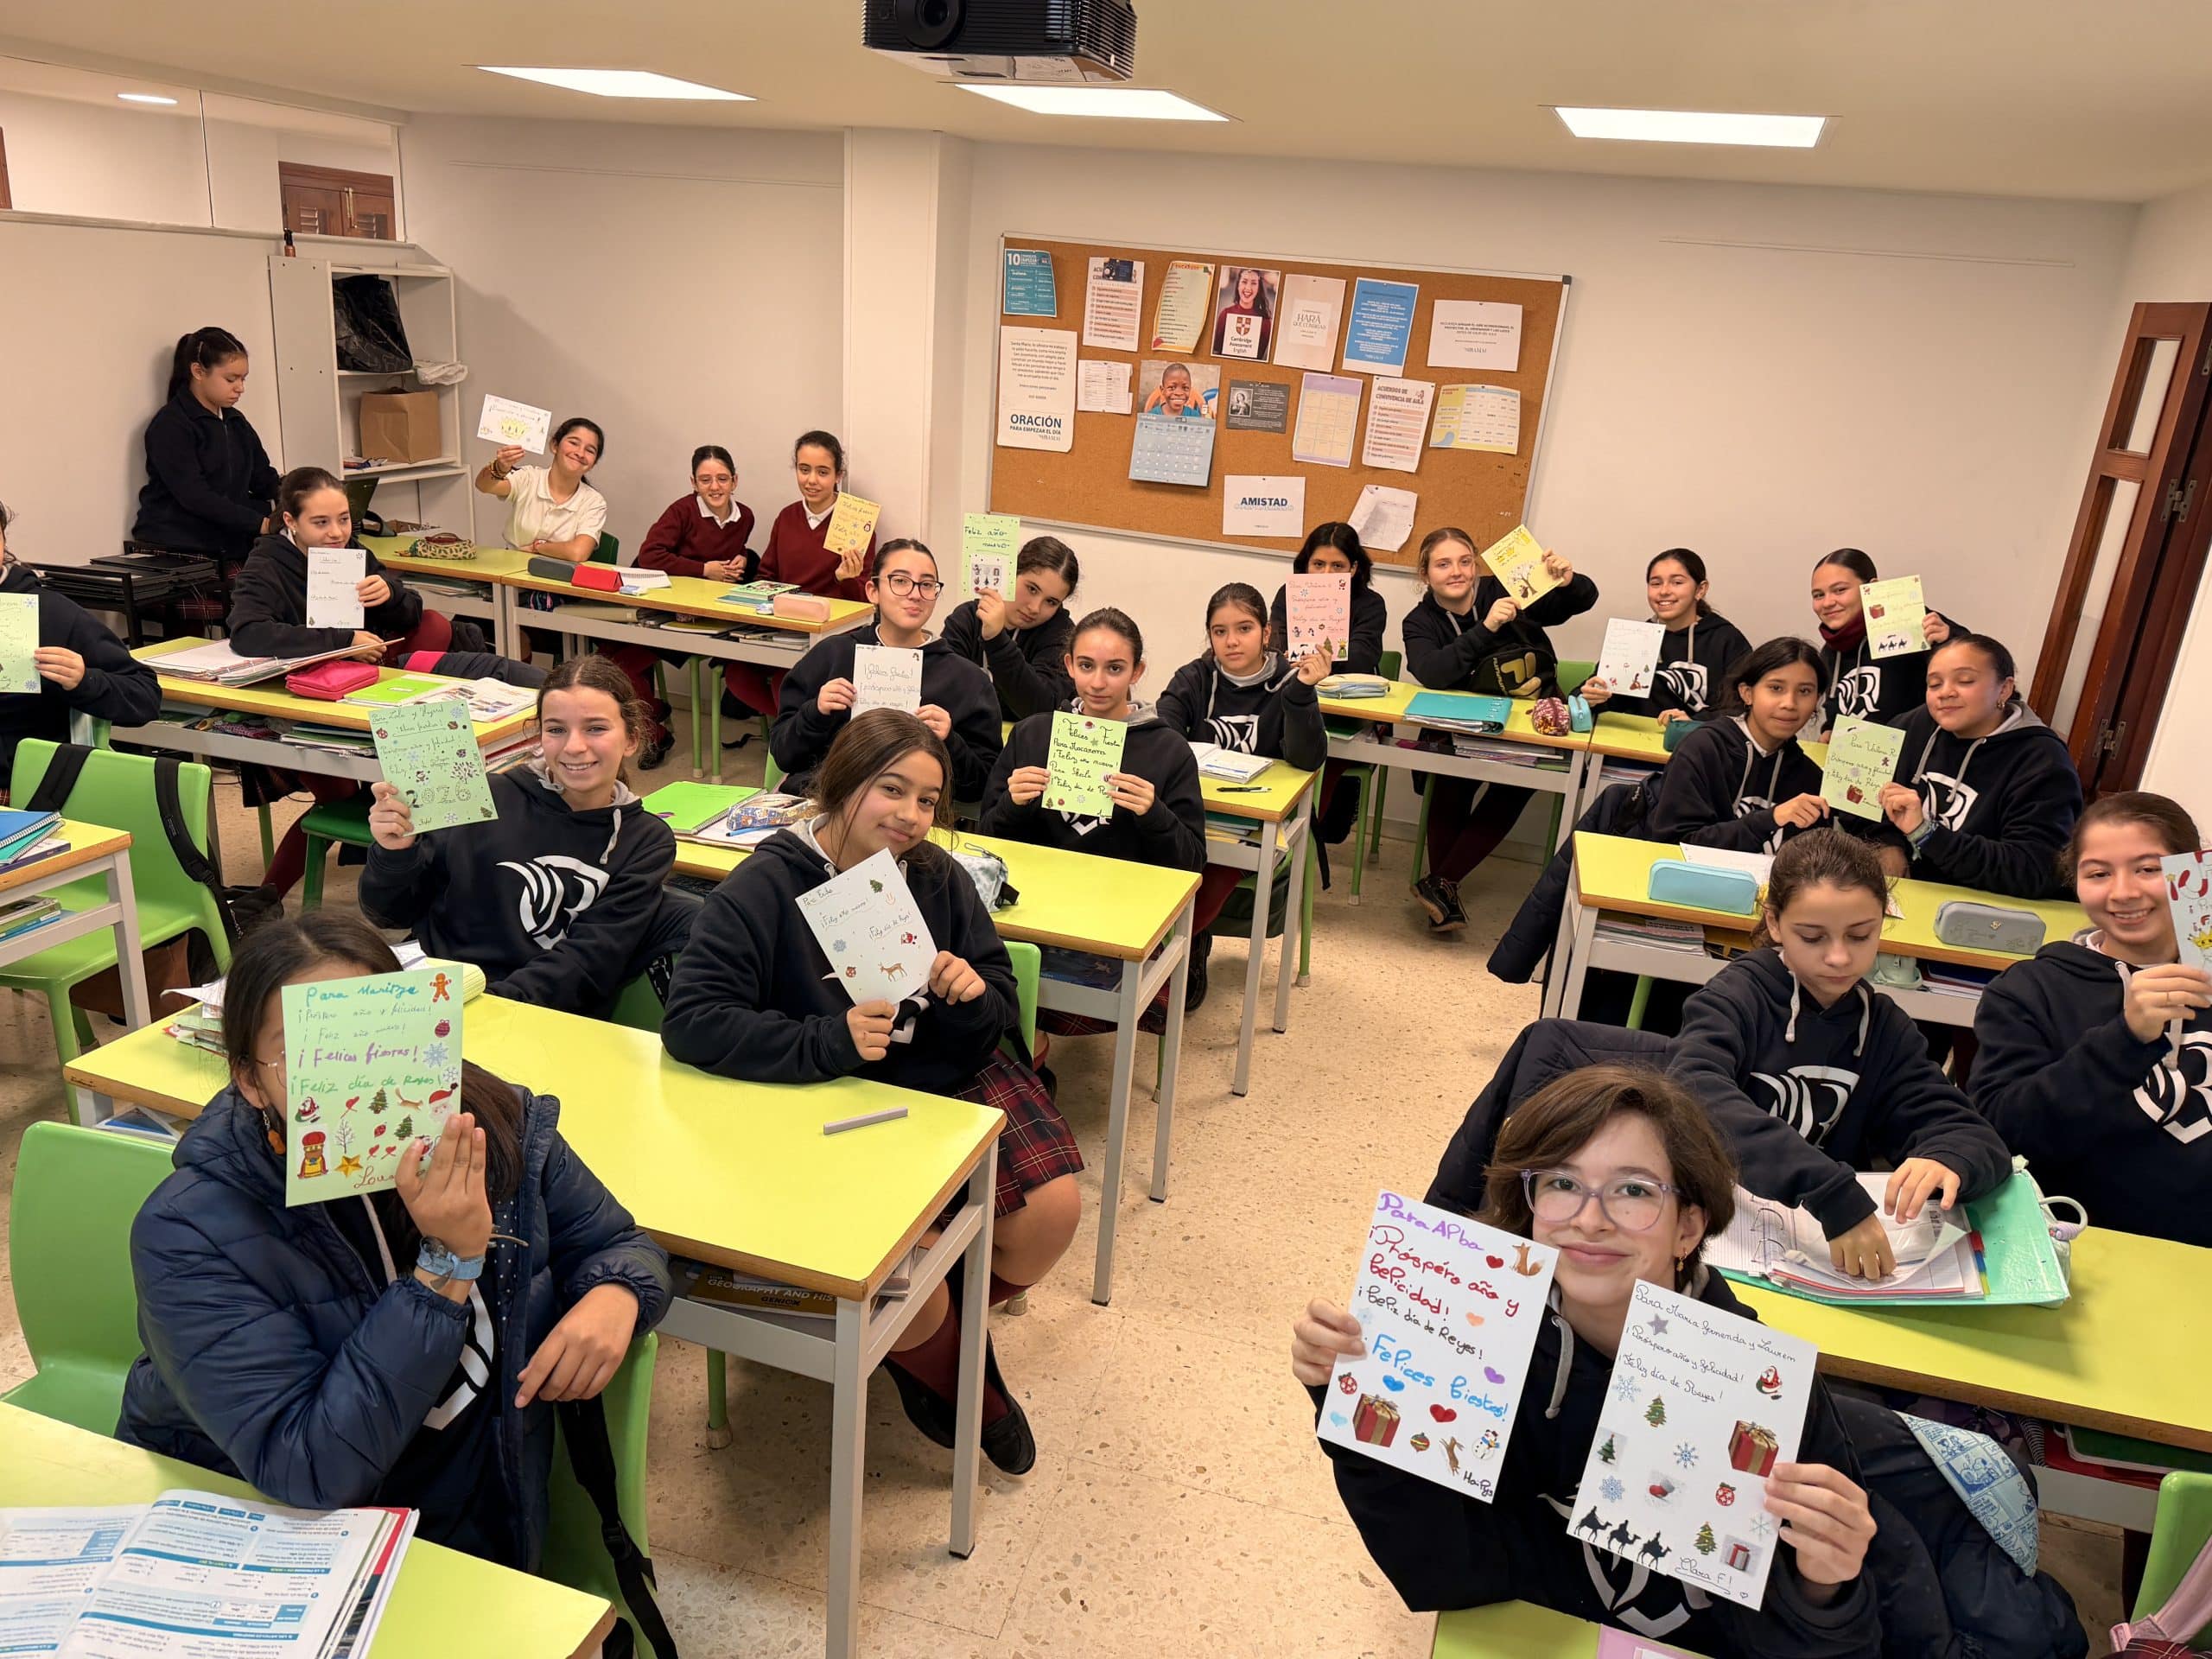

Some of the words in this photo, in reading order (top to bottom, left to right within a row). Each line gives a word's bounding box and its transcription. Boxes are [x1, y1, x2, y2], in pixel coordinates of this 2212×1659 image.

[1007, 253, 1020, 265] 10
[1010, 414, 1062, 429] ORACIÓN
[1240, 497, 1287, 506] AMISTAD
[307, 987, 348, 1007] Para
[381, 1076, 397, 1086] de
[1376, 1192, 1431, 1230] Para
[783, 1289, 810, 1299] AND
[1468, 1280, 1500, 1300] año
[1505, 1299, 1519, 1318] y
[1404, 1307, 1421, 1326] día
[1424, 1319, 1434, 1334] de
[1636, 1284, 1663, 1310] Para
[1748, 1342, 1755, 1351] y
[1691, 1359, 1698, 1370] y
[1650, 1366, 1667, 1382] día
[1670, 1376, 1680, 1388] de
